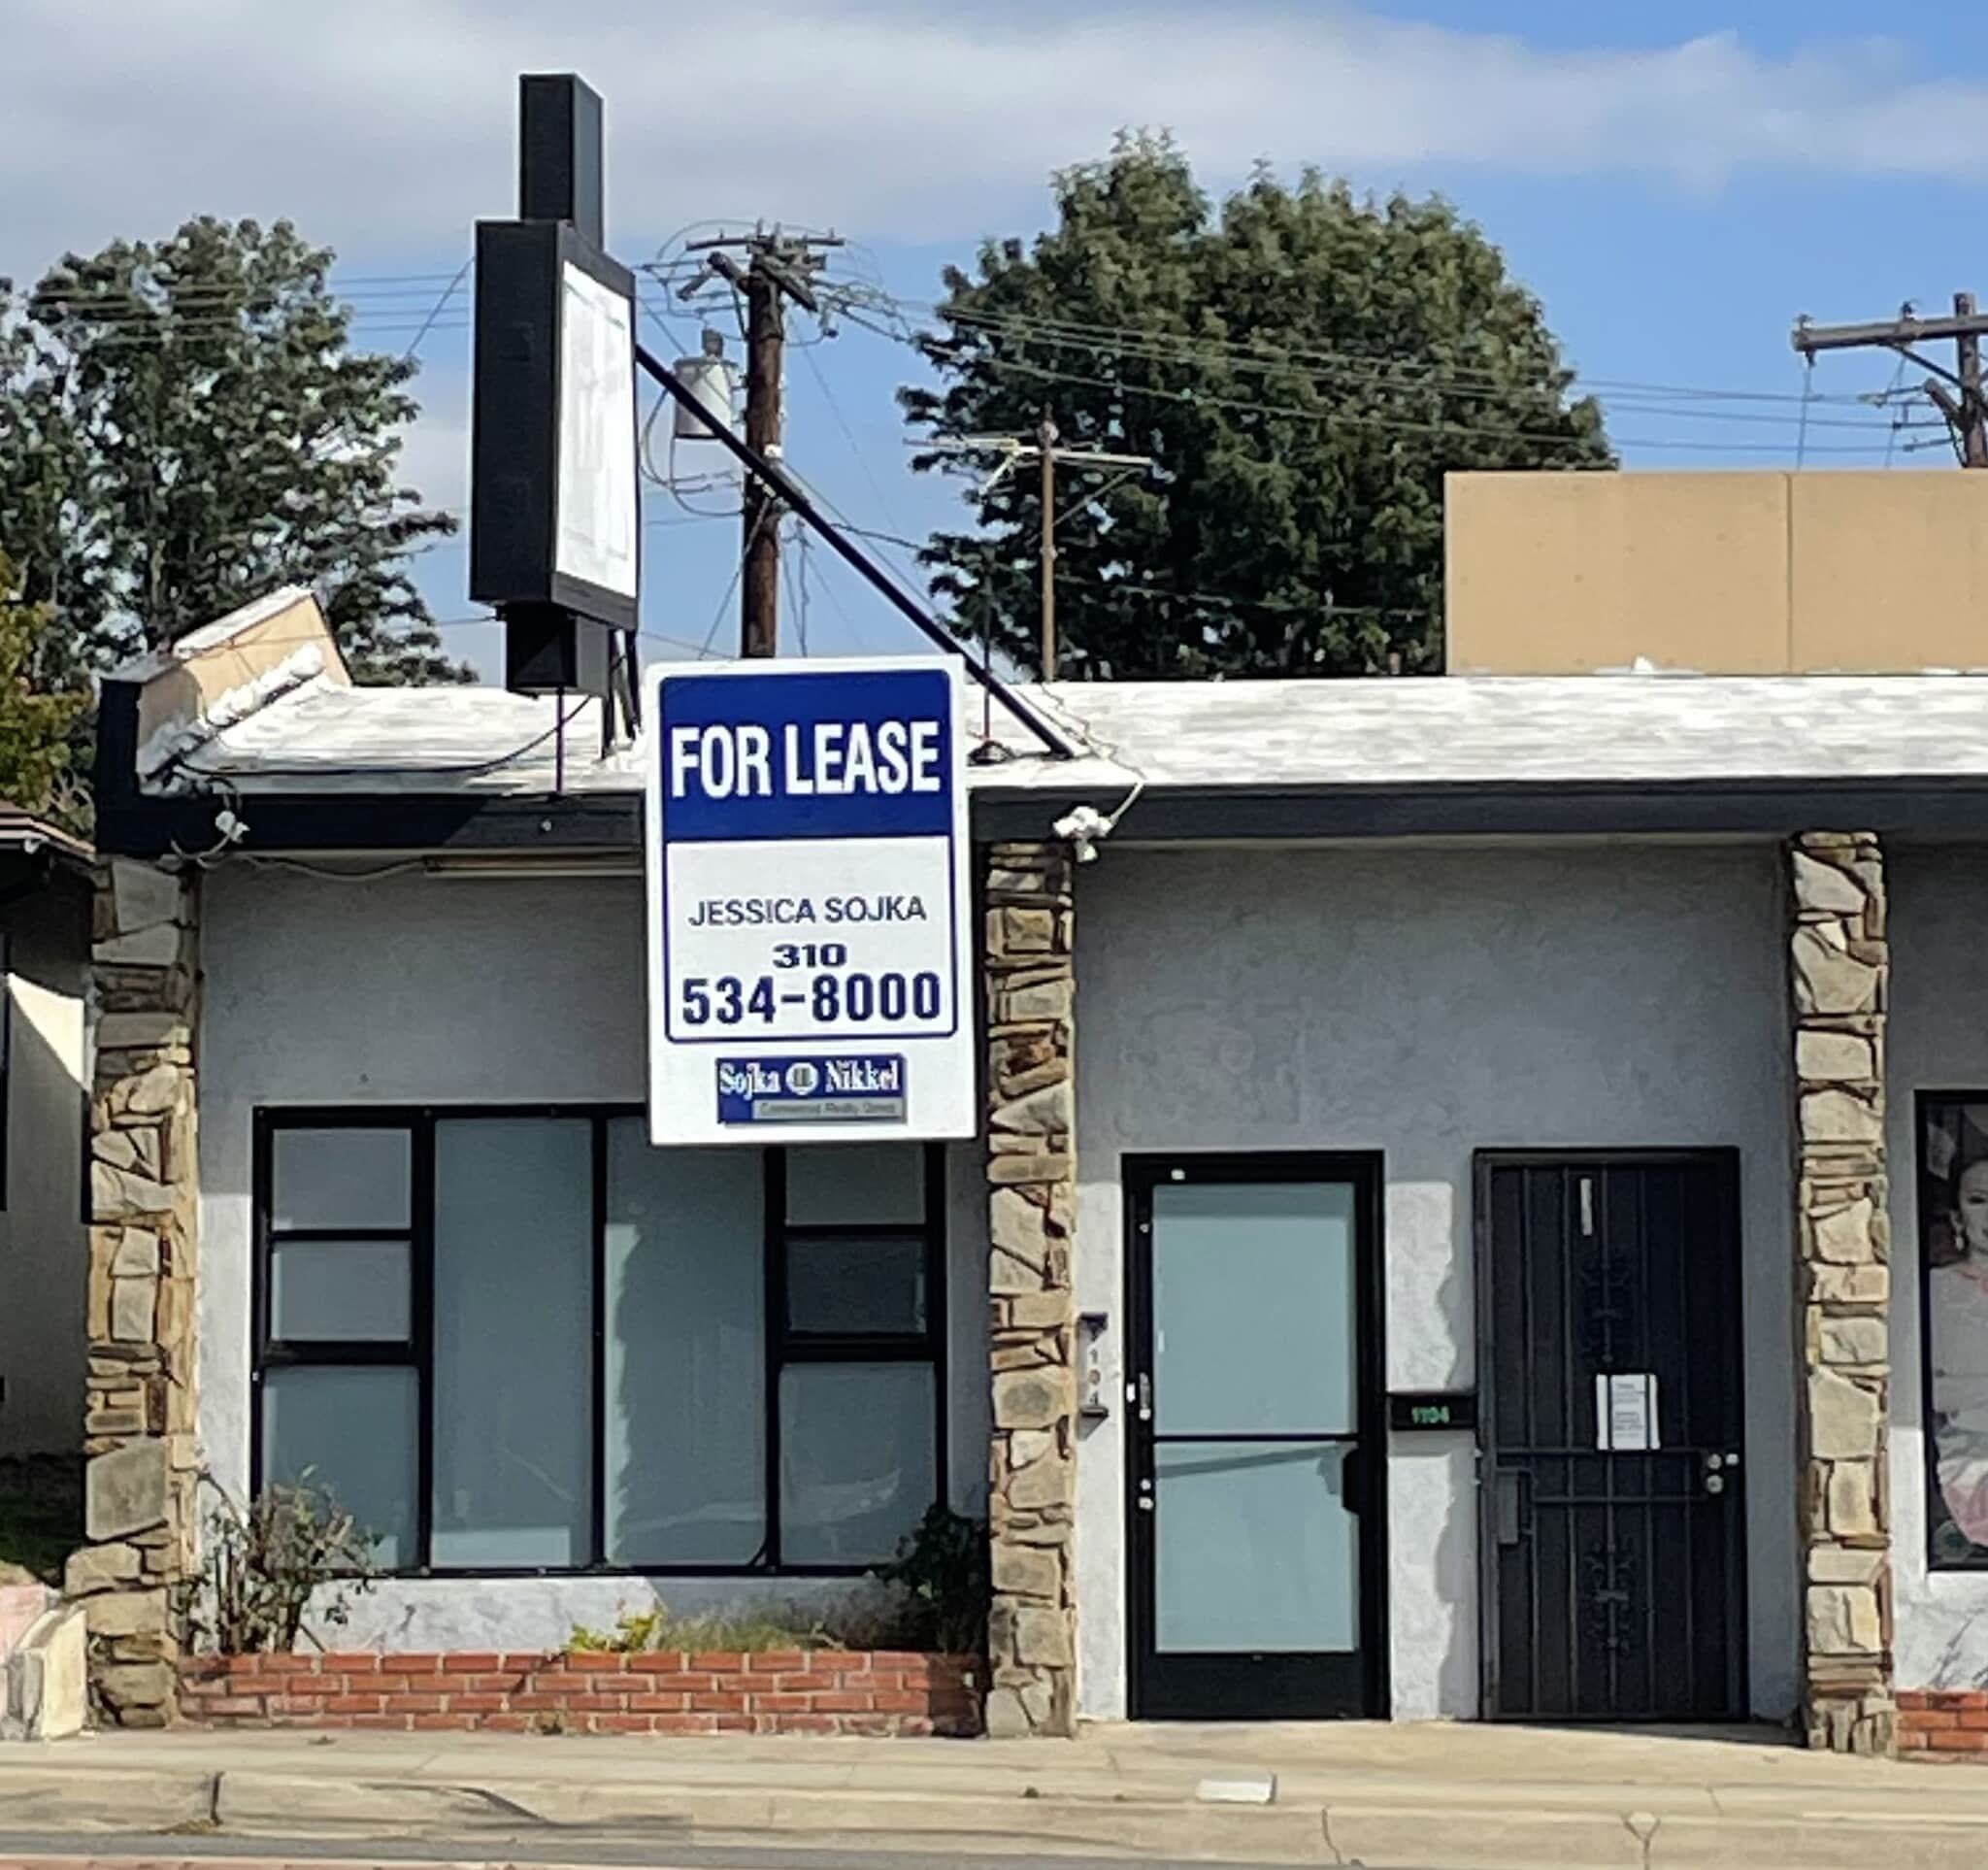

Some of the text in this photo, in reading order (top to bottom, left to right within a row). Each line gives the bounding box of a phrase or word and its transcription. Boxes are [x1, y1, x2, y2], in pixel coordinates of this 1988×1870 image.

[672, 721, 941, 798] FOR LEASE
[688, 896, 927, 926] JESSICA SOJKA
[773, 943, 846, 968] 310
[682, 972, 941, 1024] 534-8000
[719, 1060, 899, 1100] Sojka Nikkel
